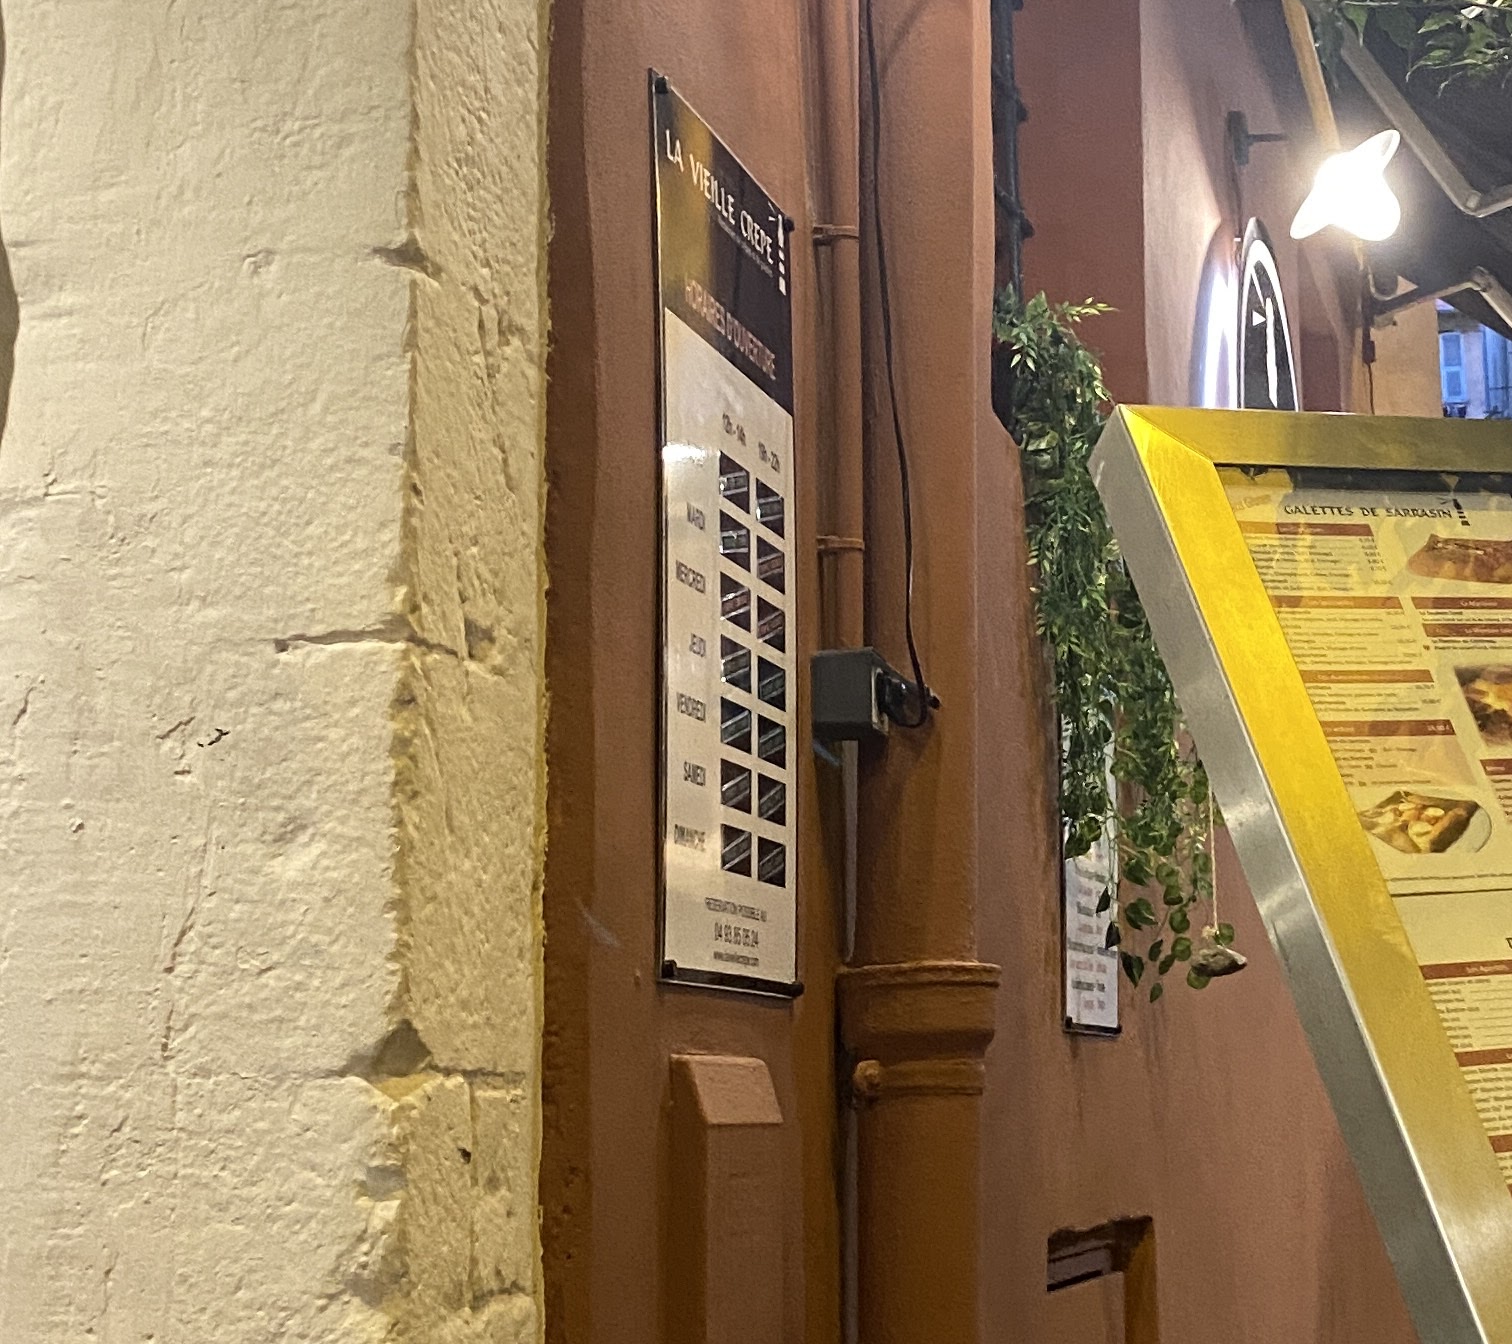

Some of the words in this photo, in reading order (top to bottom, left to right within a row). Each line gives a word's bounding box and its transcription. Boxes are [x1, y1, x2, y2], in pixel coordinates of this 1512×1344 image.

[665, 129, 684, 173] LA
[689, 154, 735, 226] VIEILLE
[1282, 504, 1355, 516] GALETTES
[1359, 507, 1379, 516] DE
[1383, 507, 1453, 518] SARRASIN
